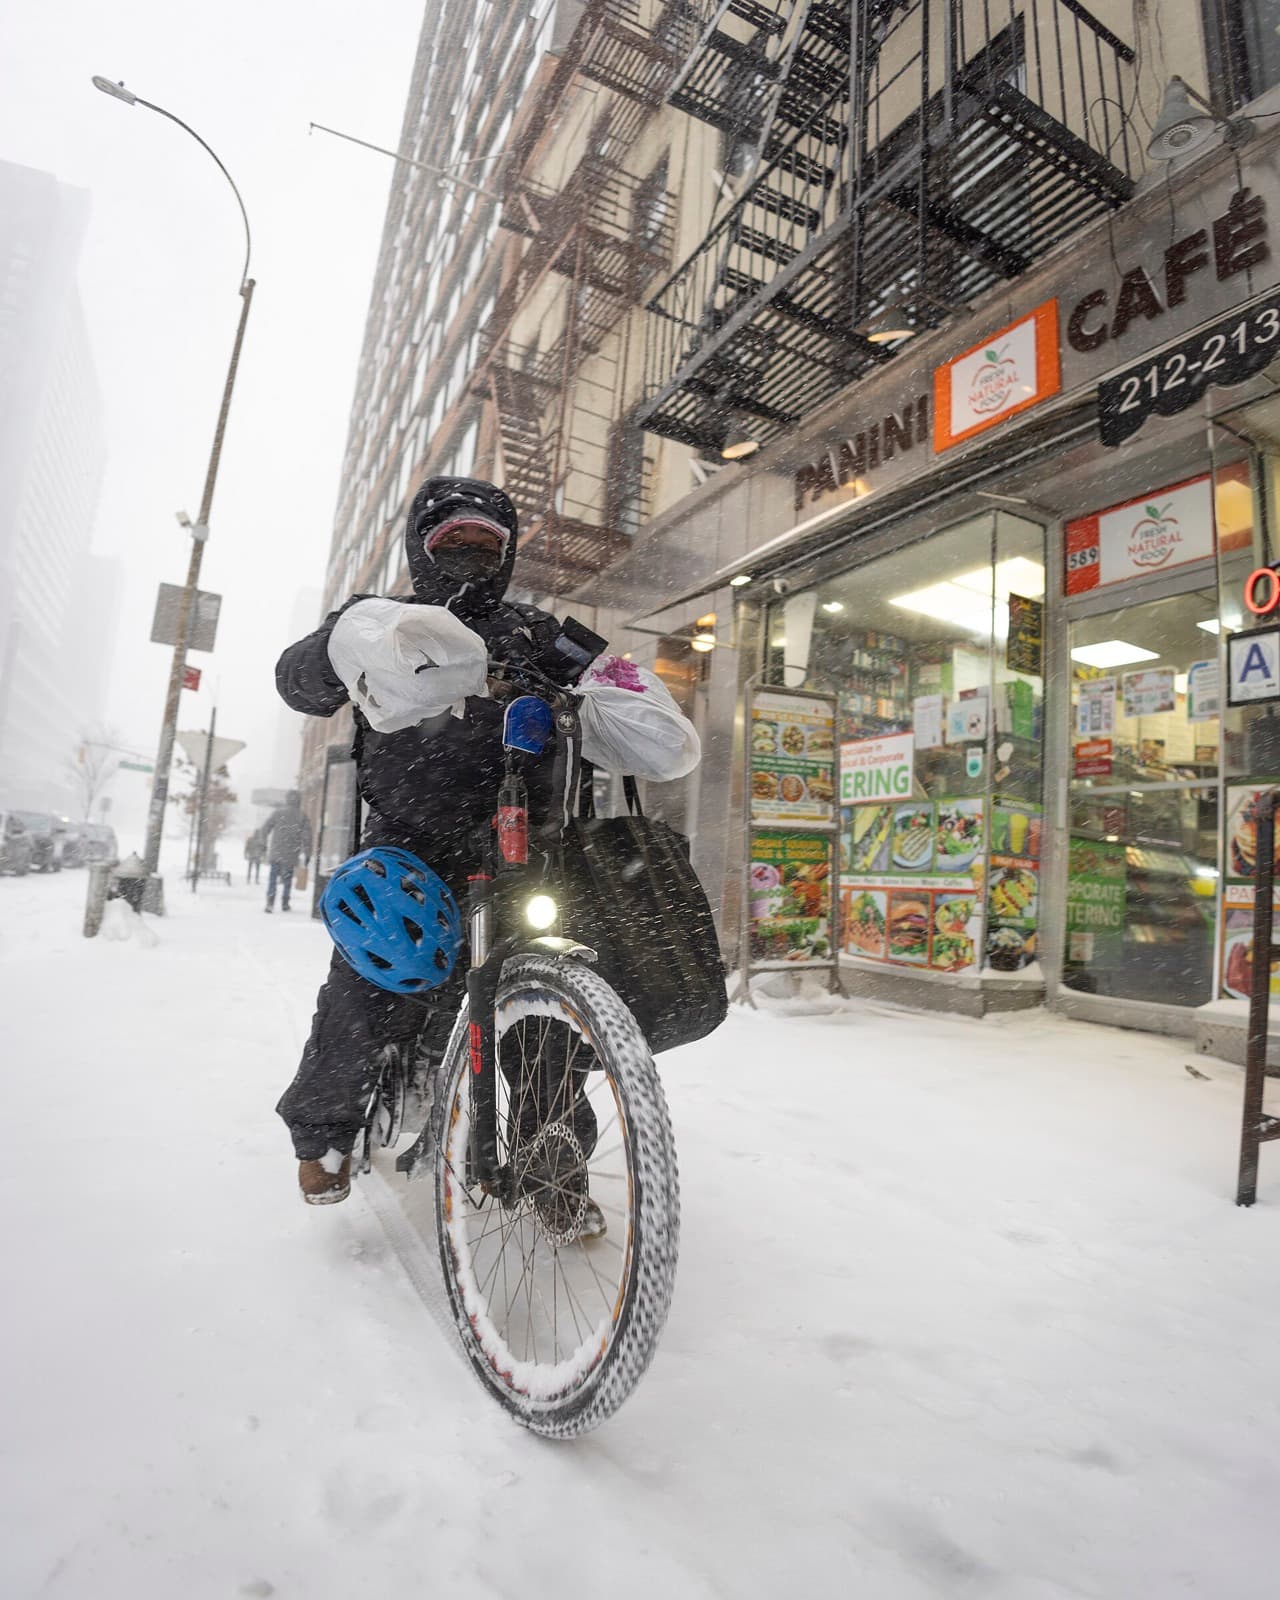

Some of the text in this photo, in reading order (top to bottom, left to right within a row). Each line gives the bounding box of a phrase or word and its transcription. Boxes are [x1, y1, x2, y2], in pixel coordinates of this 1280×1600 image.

[1068, 187, 1272, 353] CAFÉ
[1119, 308, 1280, 414] 212-213
[967, 370, 1019, 405] NATURAL
[794, 393, 928, 511] PANINI
[1128, 531, 1184, 557] NATURAL
[1140, 525, 1168, 540] FRESH
[1069, 547, 1098, 569] 589
[1141, 547, 1168, 561] FOOD
[1239, 643, 1272, 683] A
[841, 765, 910, 799] ERING
